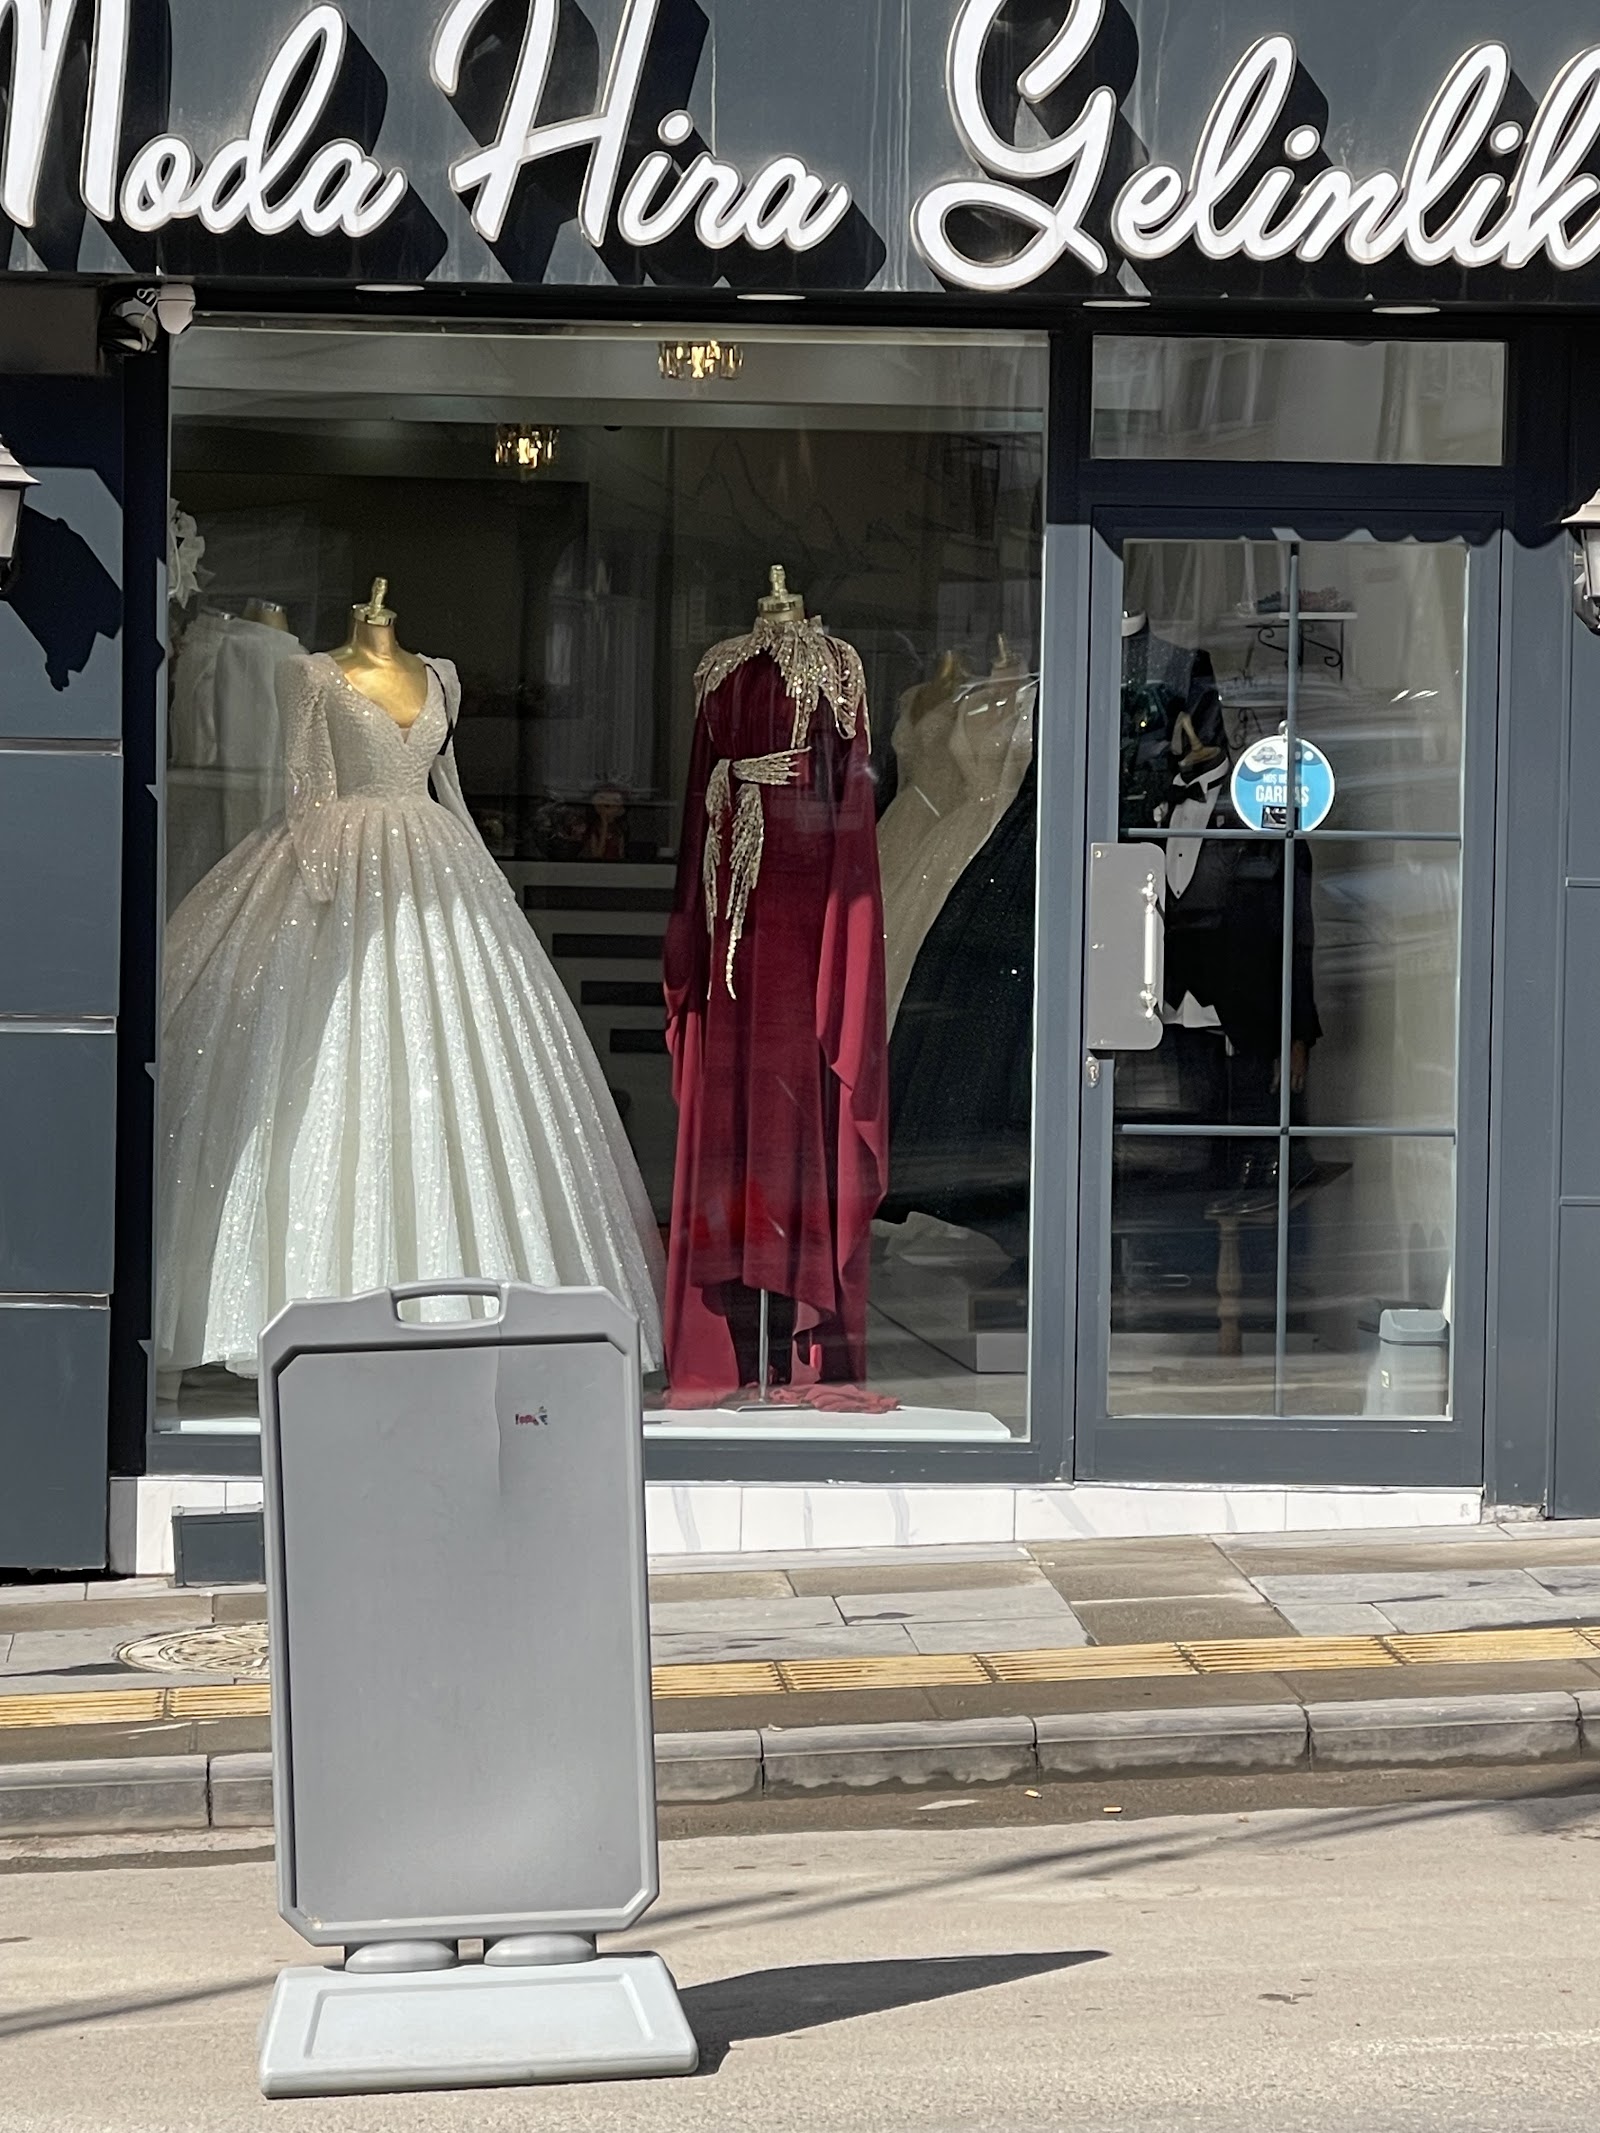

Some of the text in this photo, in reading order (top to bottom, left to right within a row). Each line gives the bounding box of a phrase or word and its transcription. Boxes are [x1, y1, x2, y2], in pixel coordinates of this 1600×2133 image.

[0, 0, 1600, 291] Moda Hira Gelinlik
